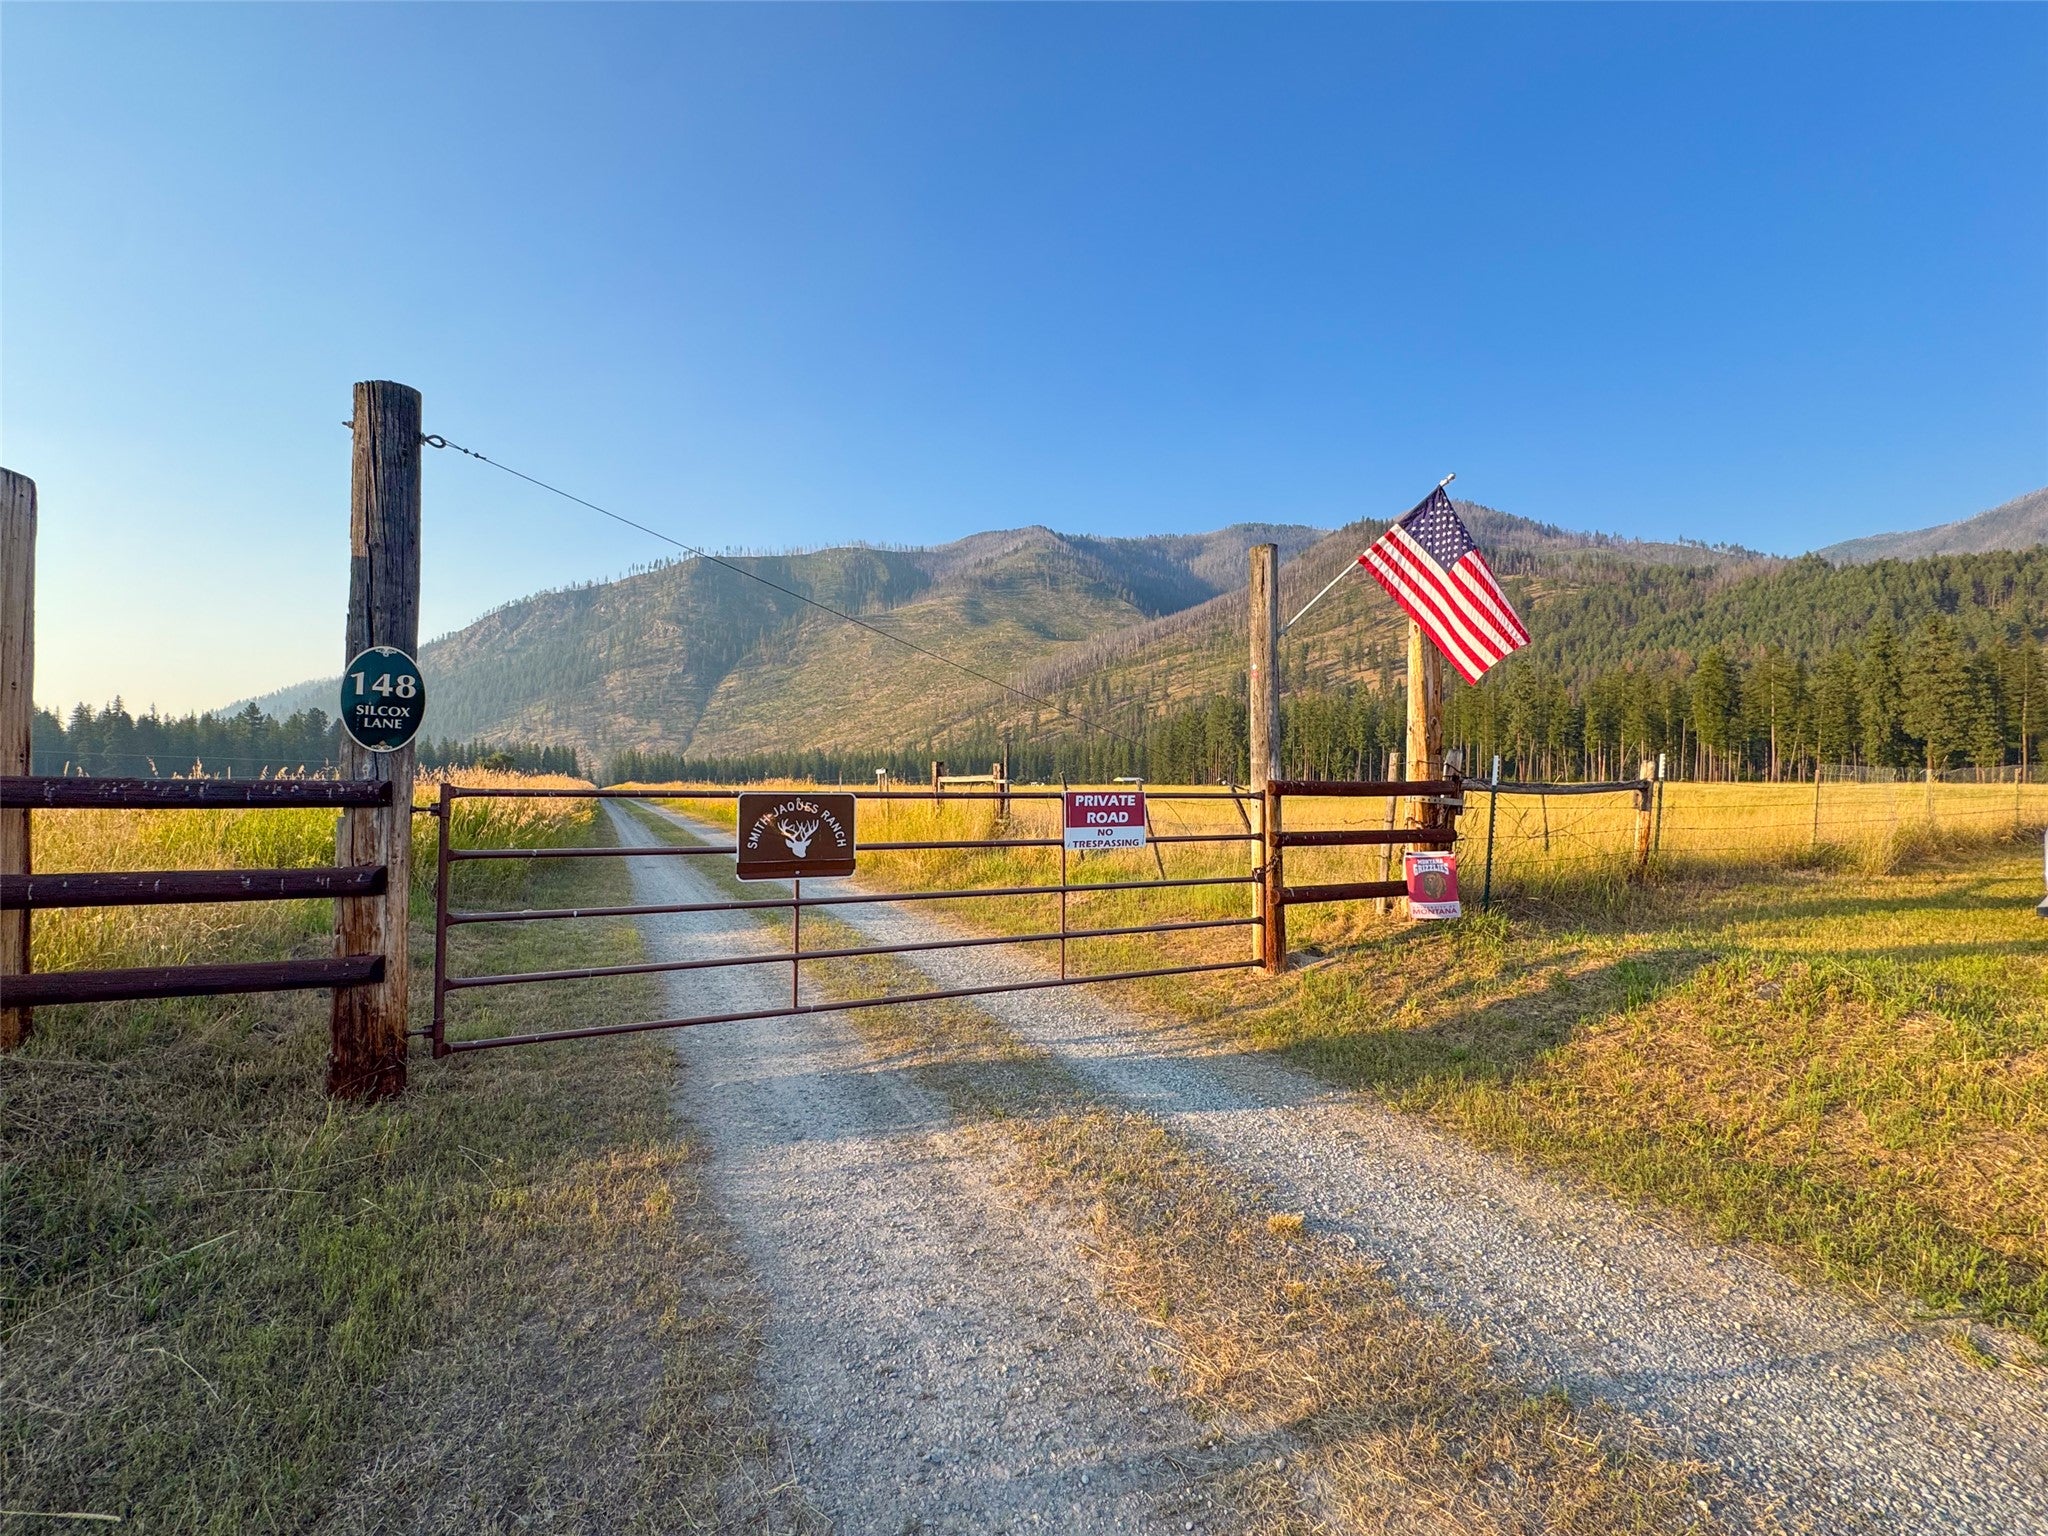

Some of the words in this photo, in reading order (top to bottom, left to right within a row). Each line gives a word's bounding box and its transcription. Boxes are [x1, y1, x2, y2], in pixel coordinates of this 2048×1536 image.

[350, 671, 416, 698] 148
[356, 704, 410, 717] SILCOX
[364, 718, 402, 729] LANE
[1075, 795, 1136, 807] PRIVATE
[1086, 812, 1129, 824] ROAD
[747, 813, 773, 850] SMITH
[772, 801, 819, 818] JAQUES
[820, 810, 847, 847] RANCH
[1097, 828, 1114, 837] NO
[1072, 839, 1140, 848] TRESPASSING
